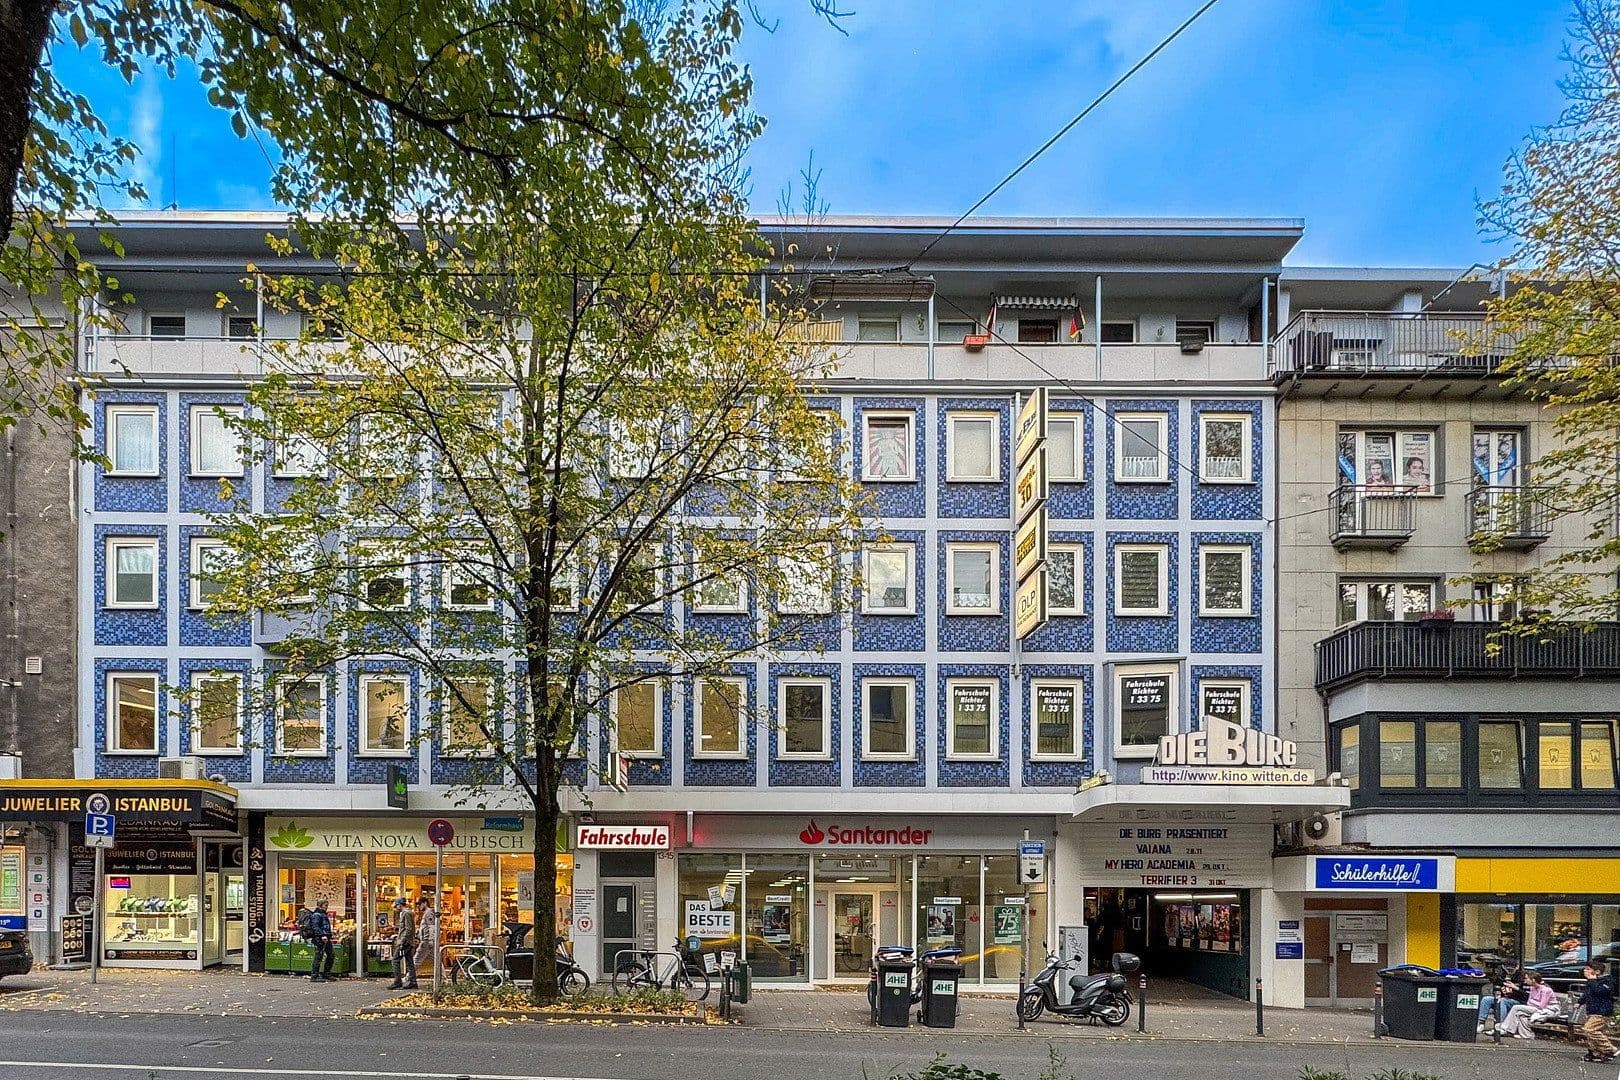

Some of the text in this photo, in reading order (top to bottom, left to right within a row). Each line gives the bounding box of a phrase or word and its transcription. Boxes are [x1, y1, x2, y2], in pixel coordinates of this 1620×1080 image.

[1126, 679, 1165, 688] Fahrschule
[954, 689, 989, 697] Fahrschule
[1132, 687, 1159, 695] Richter
[1137, 695, 1148, 703] 33
[1150, 695, 1161, 703] 75
[964, 704, 974, 712] 33
[976, 704, 986, 712] 75
[1215, 705, 1226, 713] 33
[1227, 705, 1238, 713] 75
[1160, 715, 1297, 766] DIE BURG
[1, 797, 193, 811] JUWELIER ISTANBUL
[579, 828, 667, 846] Fahrschule
[828, 826, 932, 845] Santander
[1120, 828, 1228, 839] DIE BURG PRÄSENTIERT
[323, 834, 363, 848] VITA
[371, 834, 418, 848] NOVA
[107, 850, 196, 858] JUWELIER ISTANBUL
[1136, 844, 1172, 855] VAIANA
[1104, 860, 1119, 870] MY
[1121, 860, 1144, 870] HERO
[1147, 860, 1196, 870] ACADEMIA
[1140, 876, 1188, 886] TERRIFIER
[1191, 876, 1197, 885] 3
[690, 903, 706, 912] DAS
[690, 914, 730, 926] BESTE
[887, 975, 906, 985] AHE
[935, 983, 953, 992] AHE
[1419, 991, 1436, 999] AHE
[1459, 998, 1477, 1006] AHE
